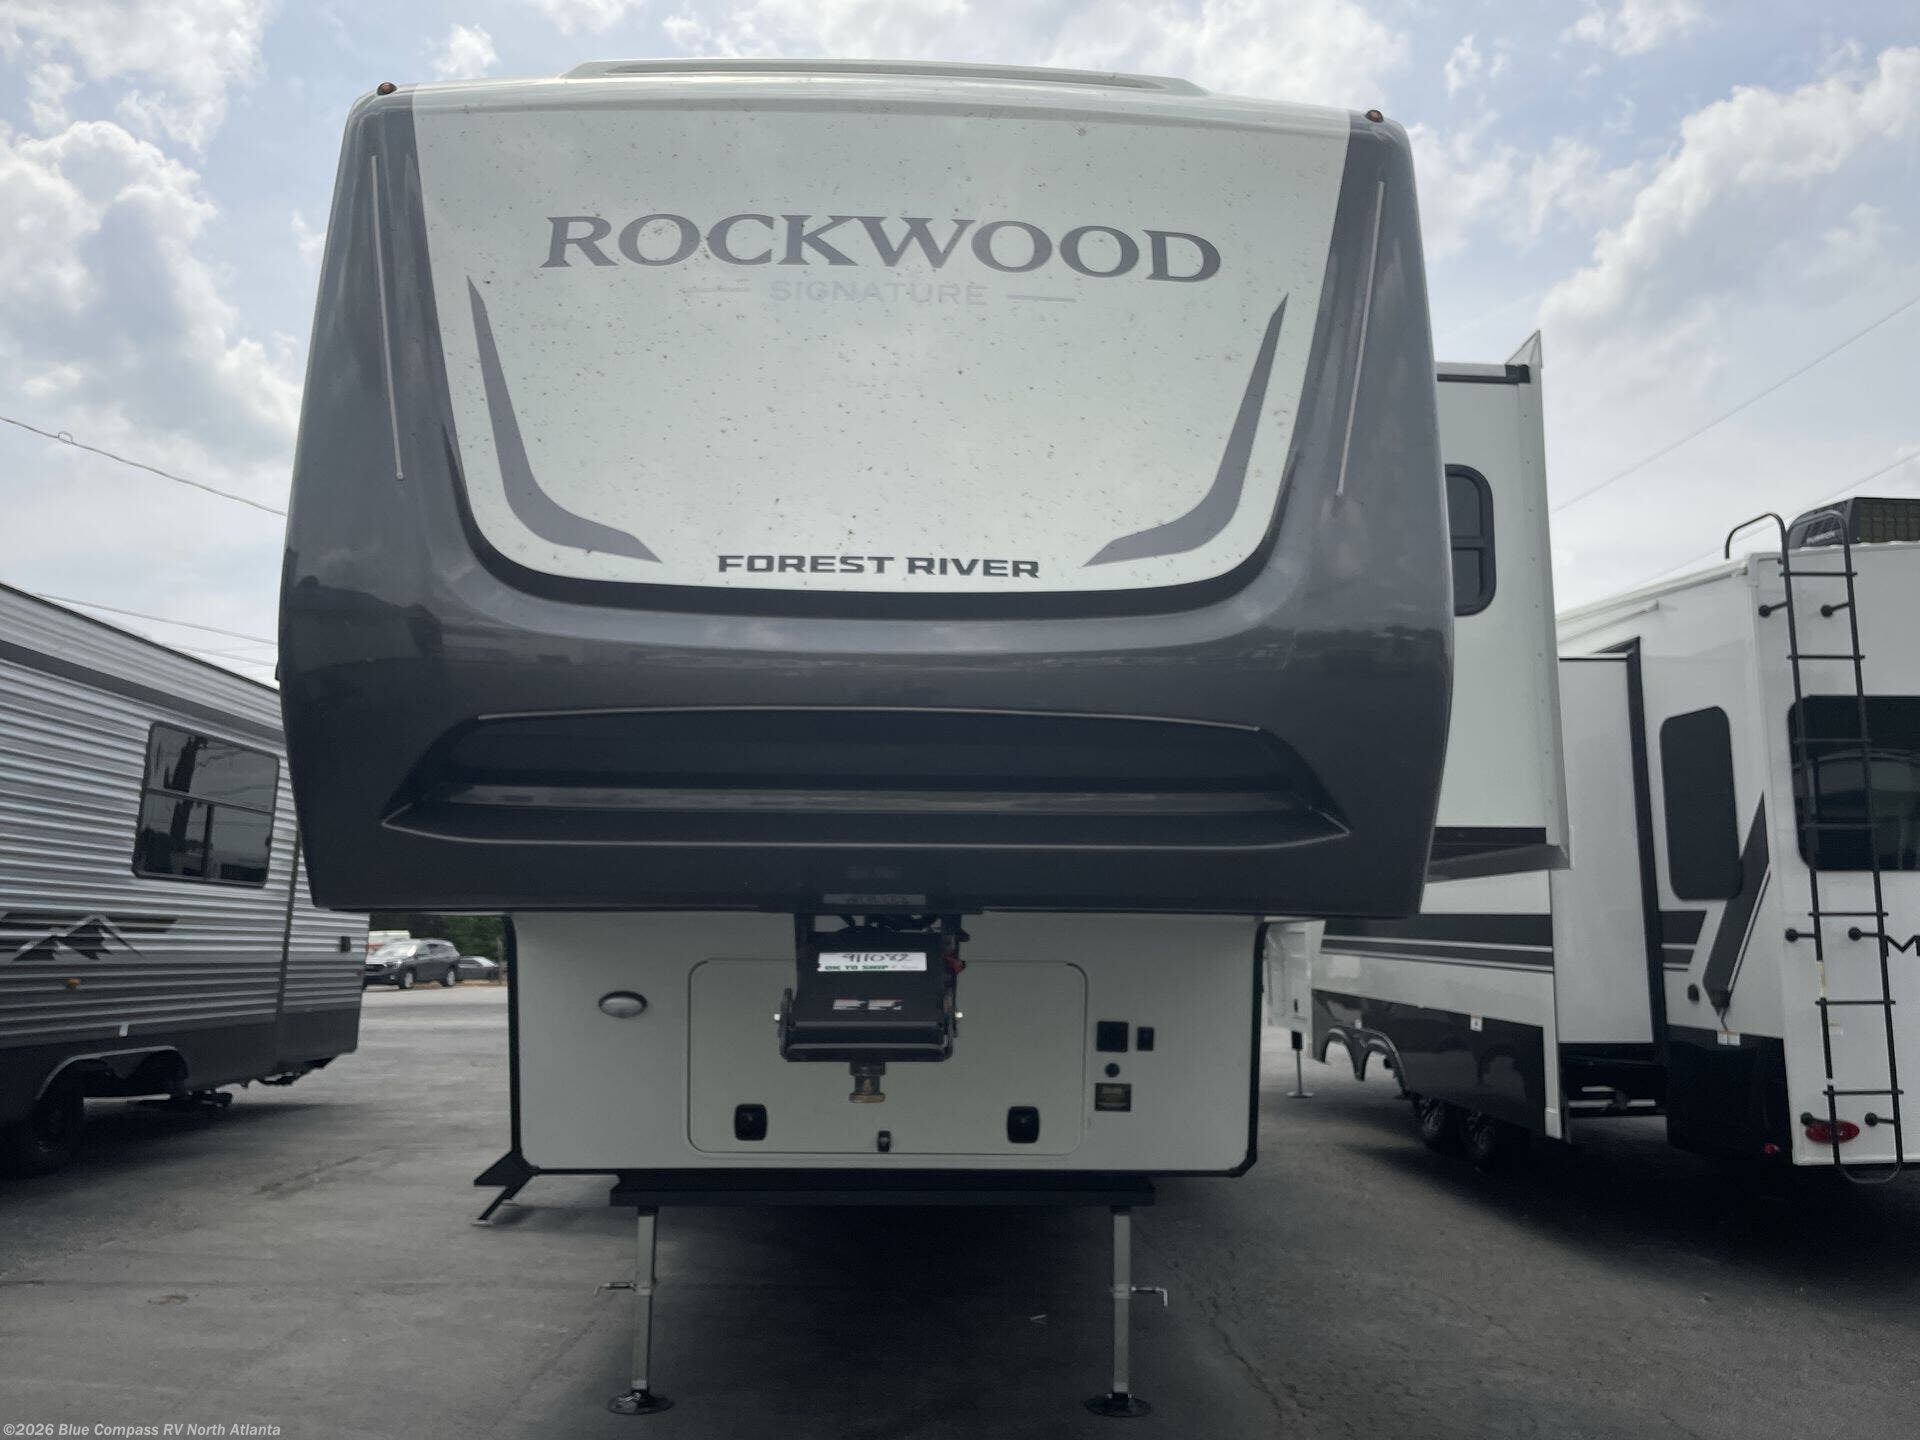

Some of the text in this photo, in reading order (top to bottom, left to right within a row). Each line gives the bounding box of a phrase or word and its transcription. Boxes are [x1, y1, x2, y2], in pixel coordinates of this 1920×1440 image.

[538, 213, 1221, 283] ROCKWOOD
[769, 279, 988, 306] SIGNATURE
[718, 555, 1040, 578] FOREST RIVER
